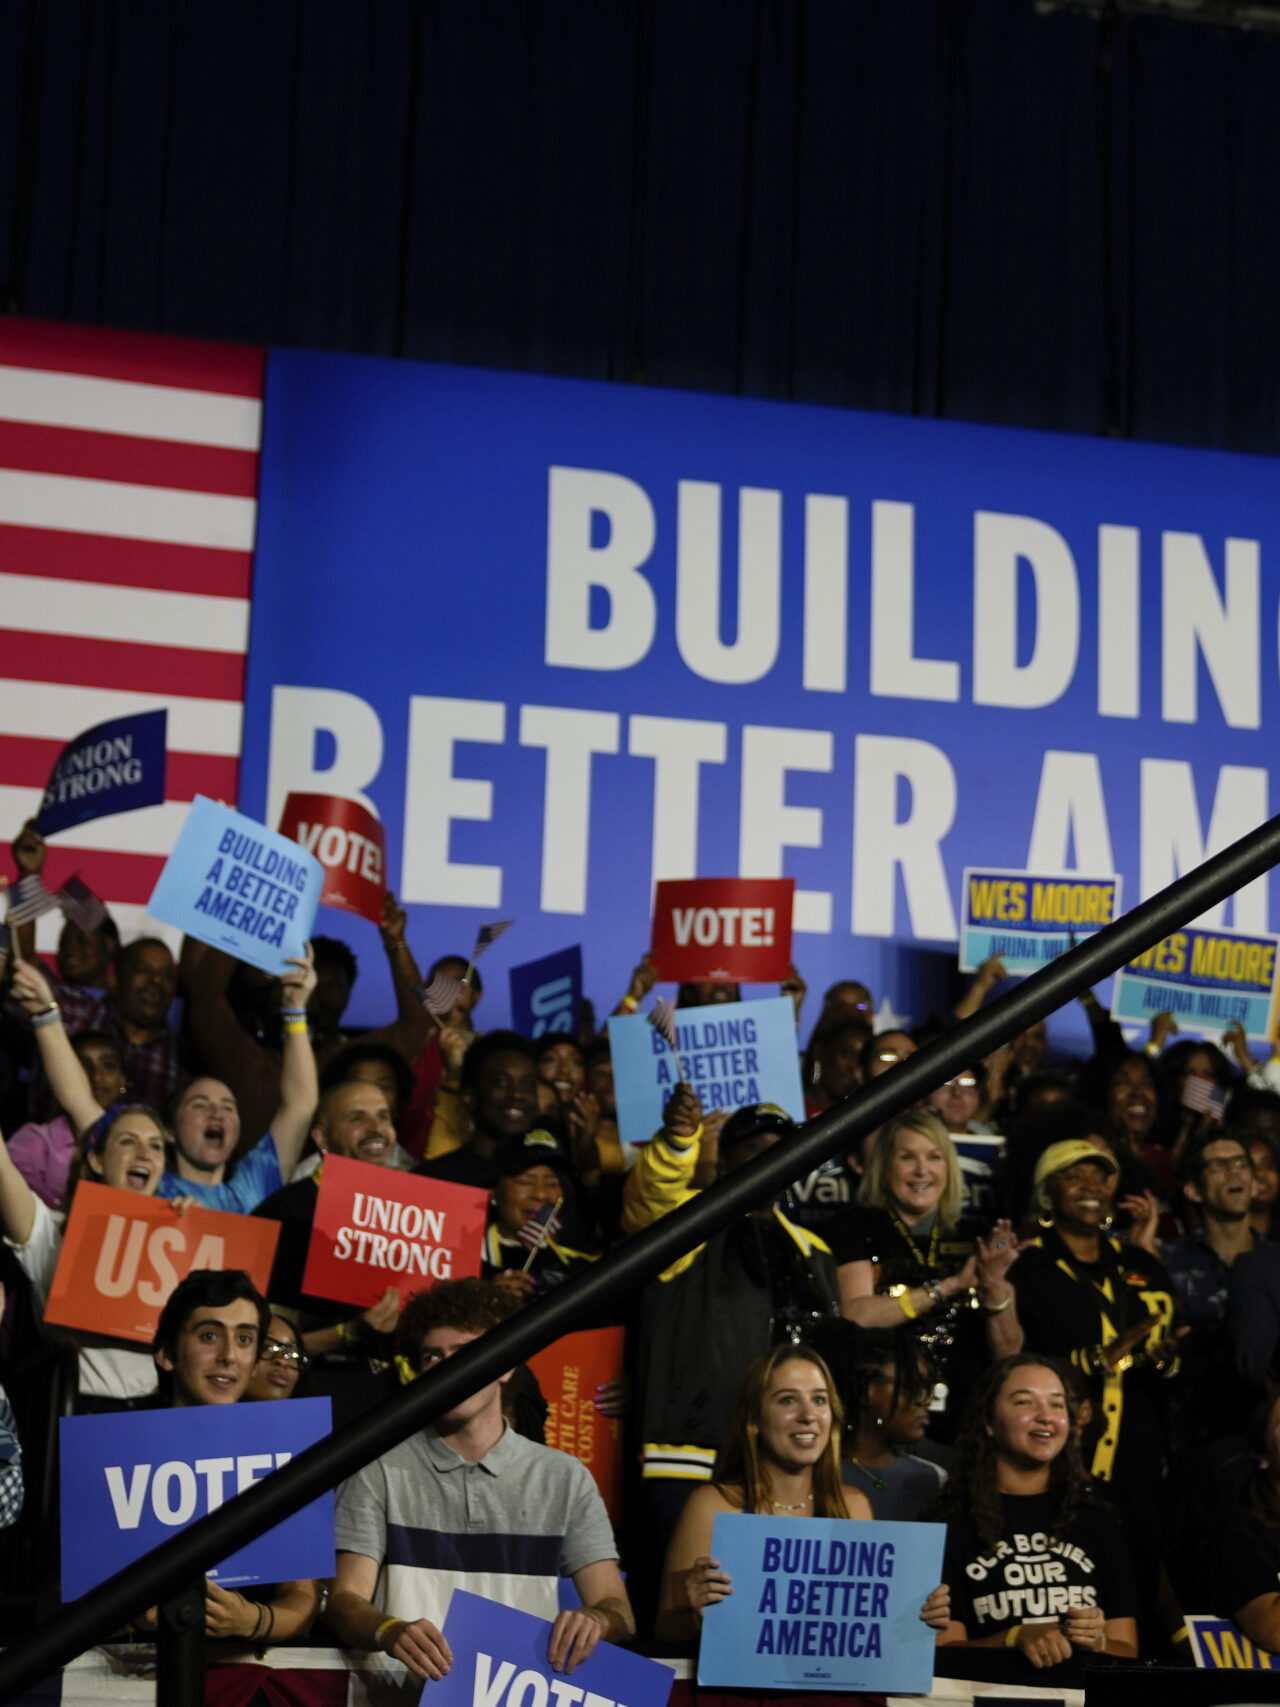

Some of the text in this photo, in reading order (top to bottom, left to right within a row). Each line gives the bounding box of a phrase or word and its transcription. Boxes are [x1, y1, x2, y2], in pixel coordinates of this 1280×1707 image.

[266, 684, 959, 942] BETTER
[218, 827, 309, 893] BUILDING
[296, 820, 382, 887] VOTE!
[206, 858, 298, 920] A BETTER
[969, 879, 1115, 926] WES MOORE
[194, 886, 287, 949] AMERICA
[671, 906, 776, 947] VOTE!
[1190, 936, 1276, 987] MOORE
[657, 1058, 671, 1084] A
[352, 1192, 446, 1244] UNION
[334, 1226, 452, 1280] STRONG
[560, 1364, 580, 1418] CARE
[761, 1537, 896, 1579] BUILDING
[1003, 1561, 1068, 1587] OUR
[758, 1577, 889, 1619] A BETTER
[972, 1585, 1099, 1625] FUTURES
[756, 1618, 882, 1659] AMERICA
